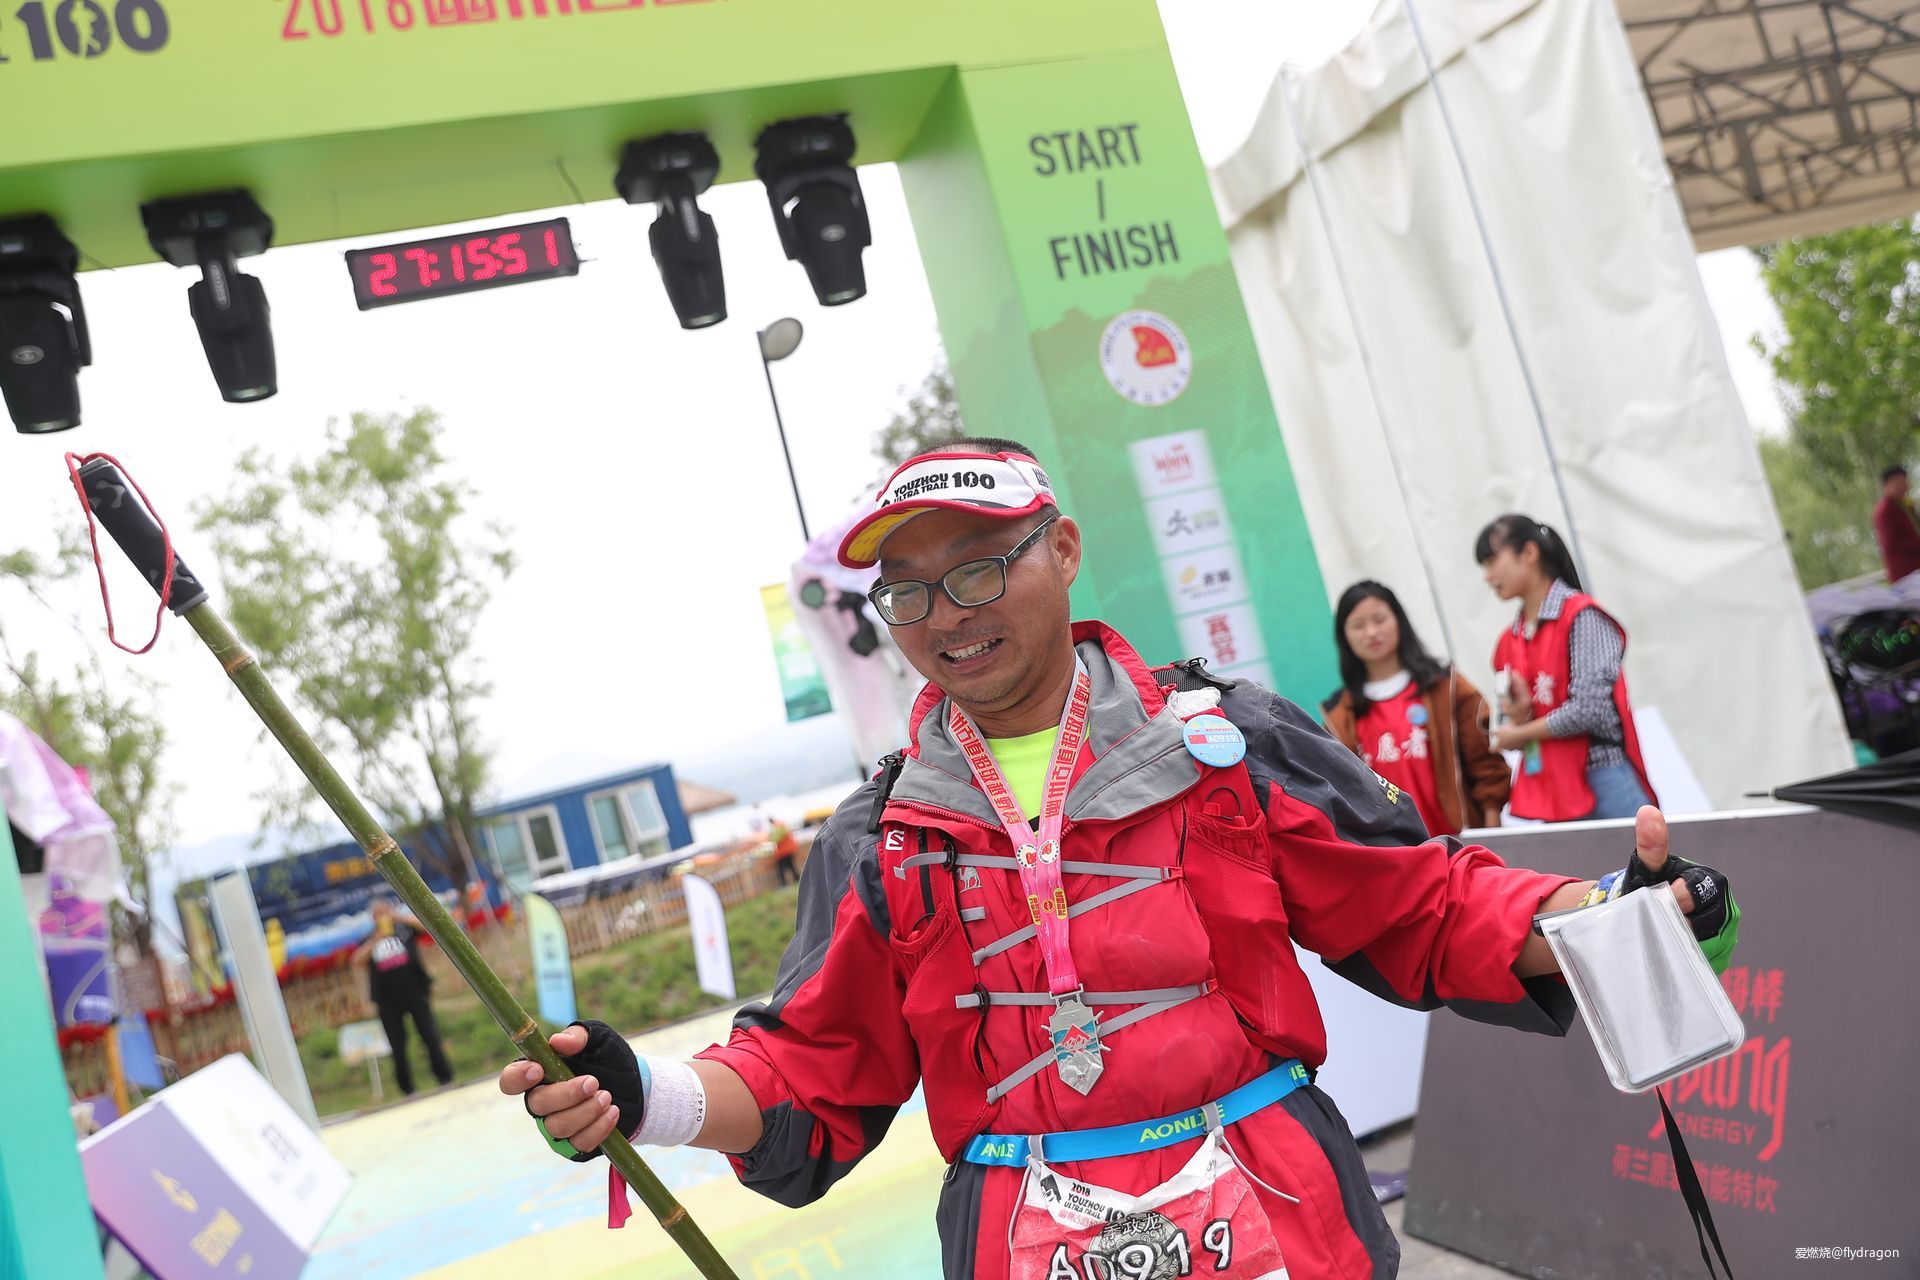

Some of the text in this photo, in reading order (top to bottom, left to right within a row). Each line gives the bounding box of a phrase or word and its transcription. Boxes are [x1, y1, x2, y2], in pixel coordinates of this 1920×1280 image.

[16, 0, 170, 60] 100
[1029, 122, 1142, 177] START
[1048, 220, 1181, 281] FINISH
[893, 471, 995, 498] YOUZHOU 100
[920, 481, 949, 494] TRAIL
[951, 701, 1023, 825] 州古道超级越野赛
[1675, 1110, 1757, 1146] ENERGY
[1068, 1192, 1105, 1213] YOUZHOU
[1071, 1182, 1091, 1198] 2018
[1063, 1201, 1102, 1220] ULTRA TRAIL
[1046, 1218, 1234, 1280] A0919
